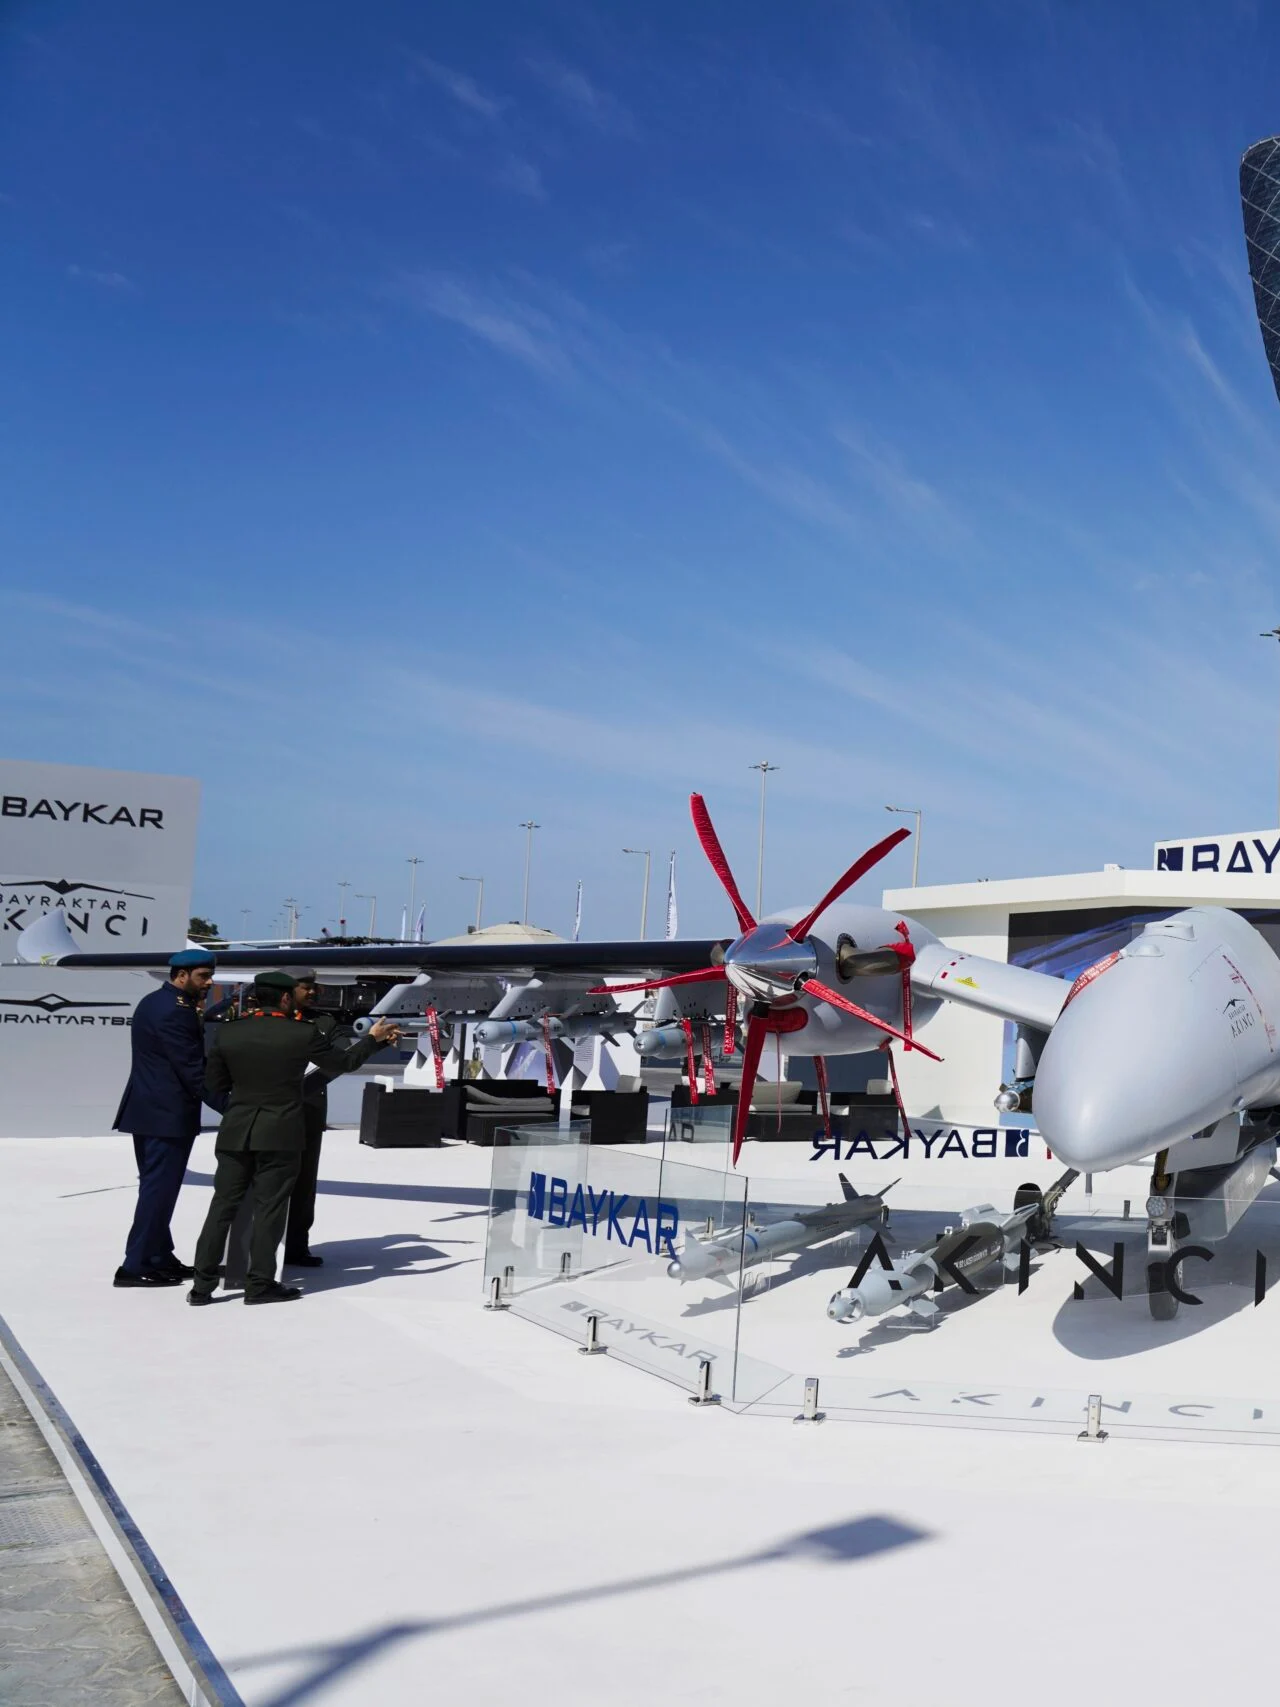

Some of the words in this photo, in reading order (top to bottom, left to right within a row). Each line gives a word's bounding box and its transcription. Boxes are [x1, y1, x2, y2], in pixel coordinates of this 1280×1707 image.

[2, 796, 164, 829] BAYKAR
[548, 1176, 678, 1260] BAYKAR
[847, 1231, 1267, 1308] AKINCI
